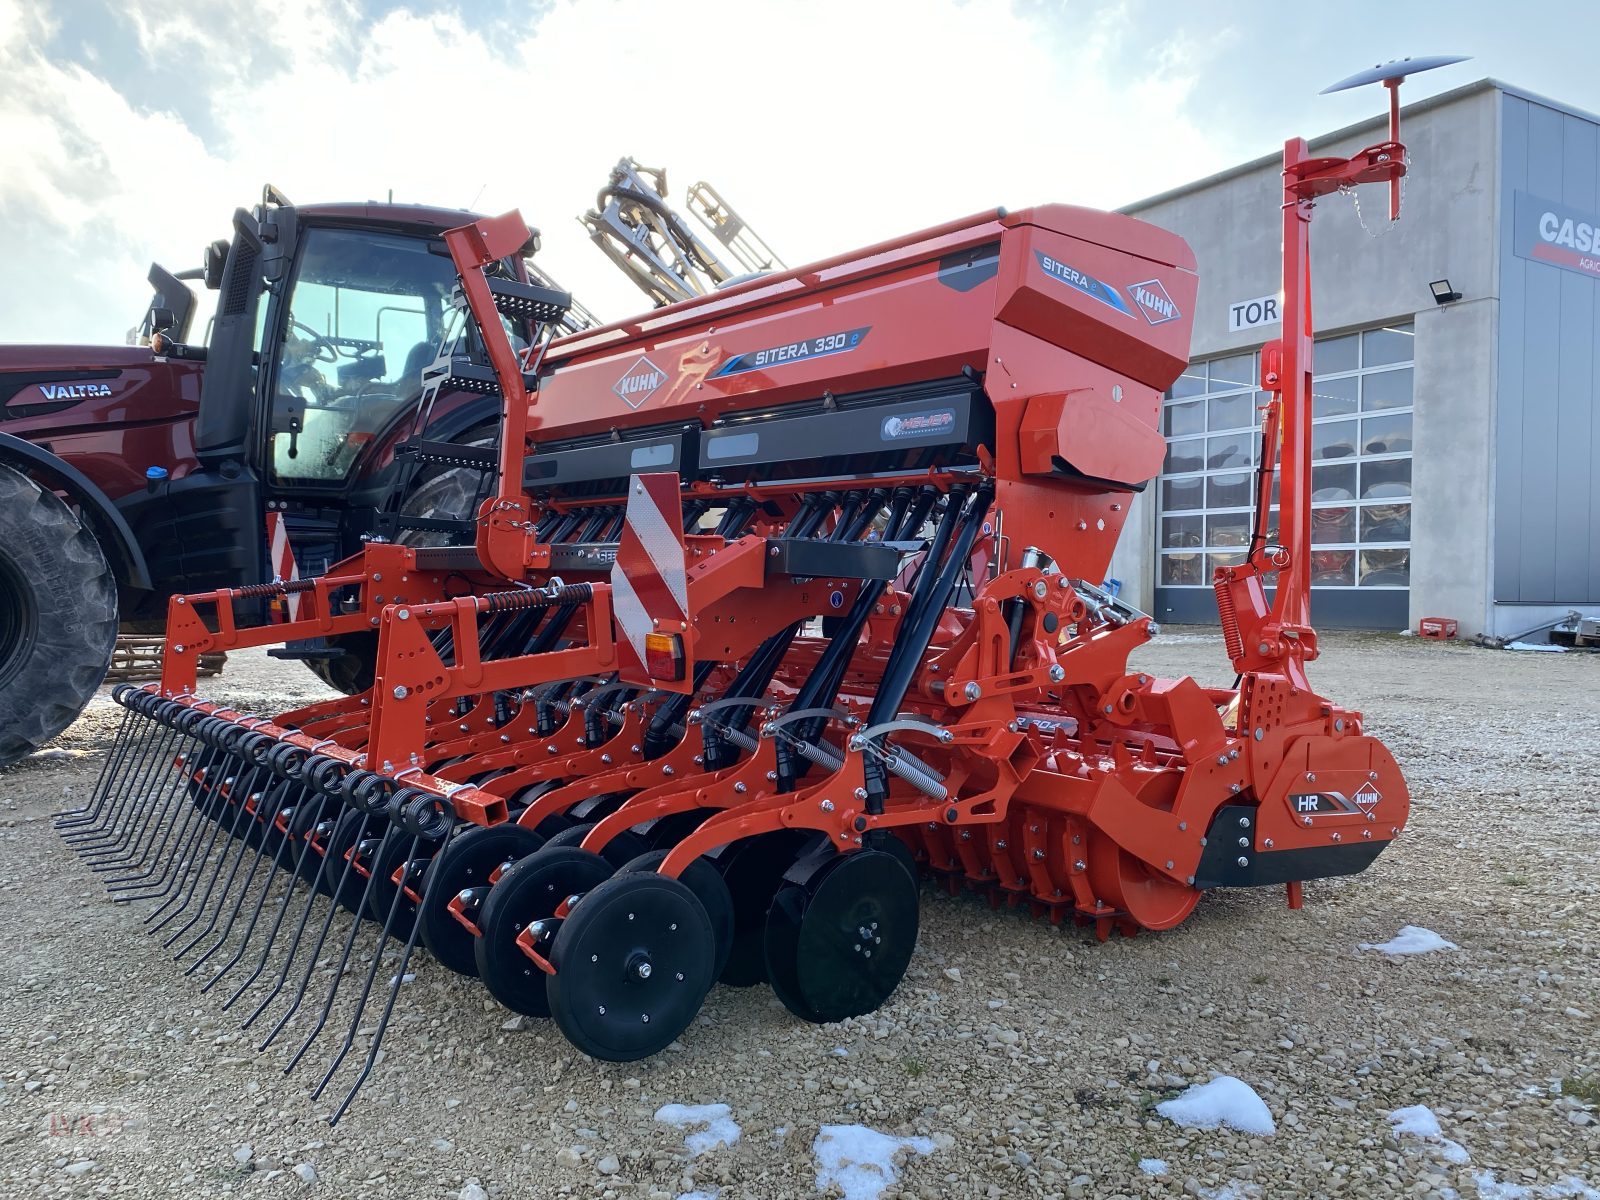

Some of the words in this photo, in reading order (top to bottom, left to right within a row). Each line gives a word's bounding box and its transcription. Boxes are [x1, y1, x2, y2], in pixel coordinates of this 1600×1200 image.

[1042, 256, 1089, 289] SITERA
[1090, 282, 1097, 292] e
[1135, 286, 1173, 318] KUHN
[1232, 298, 1278, 327] TOR
[755, 342, 809, 366] SITERA
[815, 333, 846, 353] 330
[850, 333, 859, 345] e
[39, 384, 112, 400] VALTRA
[620, 371, 659, 395] KUHN
[600, 551, 618, 563] SEE
[1298, 795, 1318, 812] HR
[1356, 793, 1378, 804] KUHN
